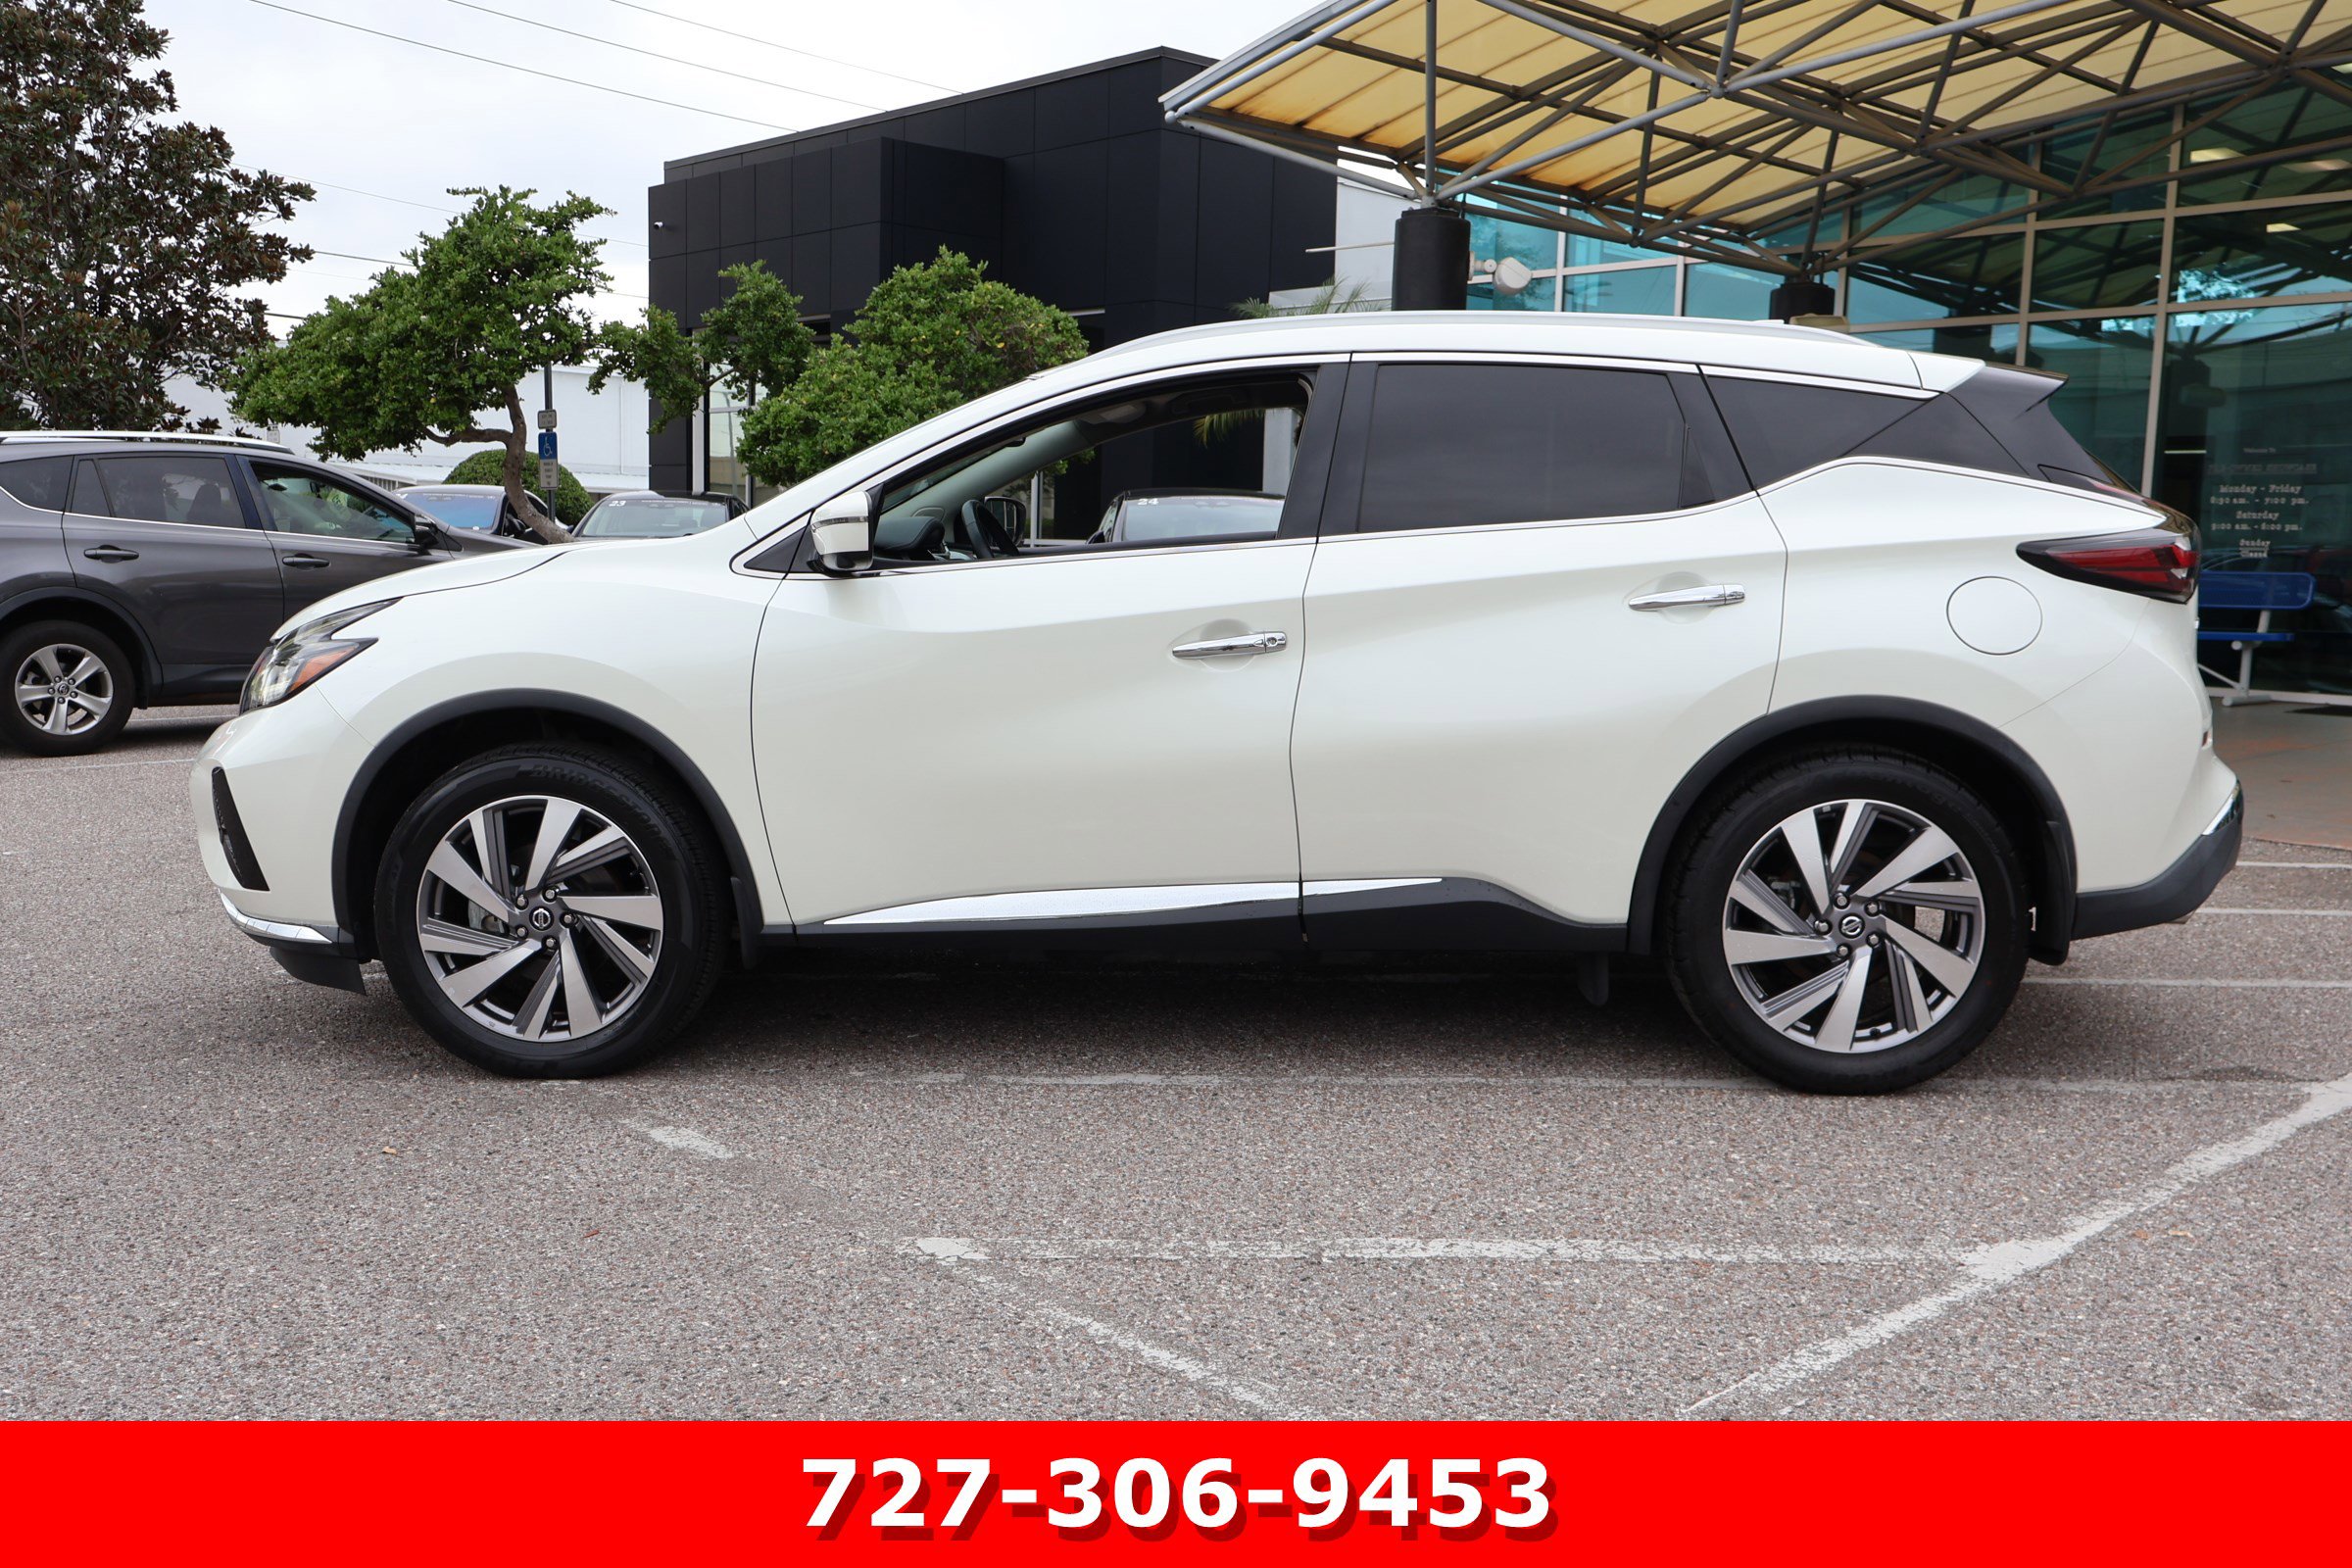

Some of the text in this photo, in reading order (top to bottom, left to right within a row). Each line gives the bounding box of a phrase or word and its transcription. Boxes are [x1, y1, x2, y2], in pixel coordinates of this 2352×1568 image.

[2219, 484, 2257, 494] Monday
[2269, 484, 2301, 494] Friday
[2235, 511, 2279, 520] Saturday
[2238, 538, 2271, 548] Sunday
